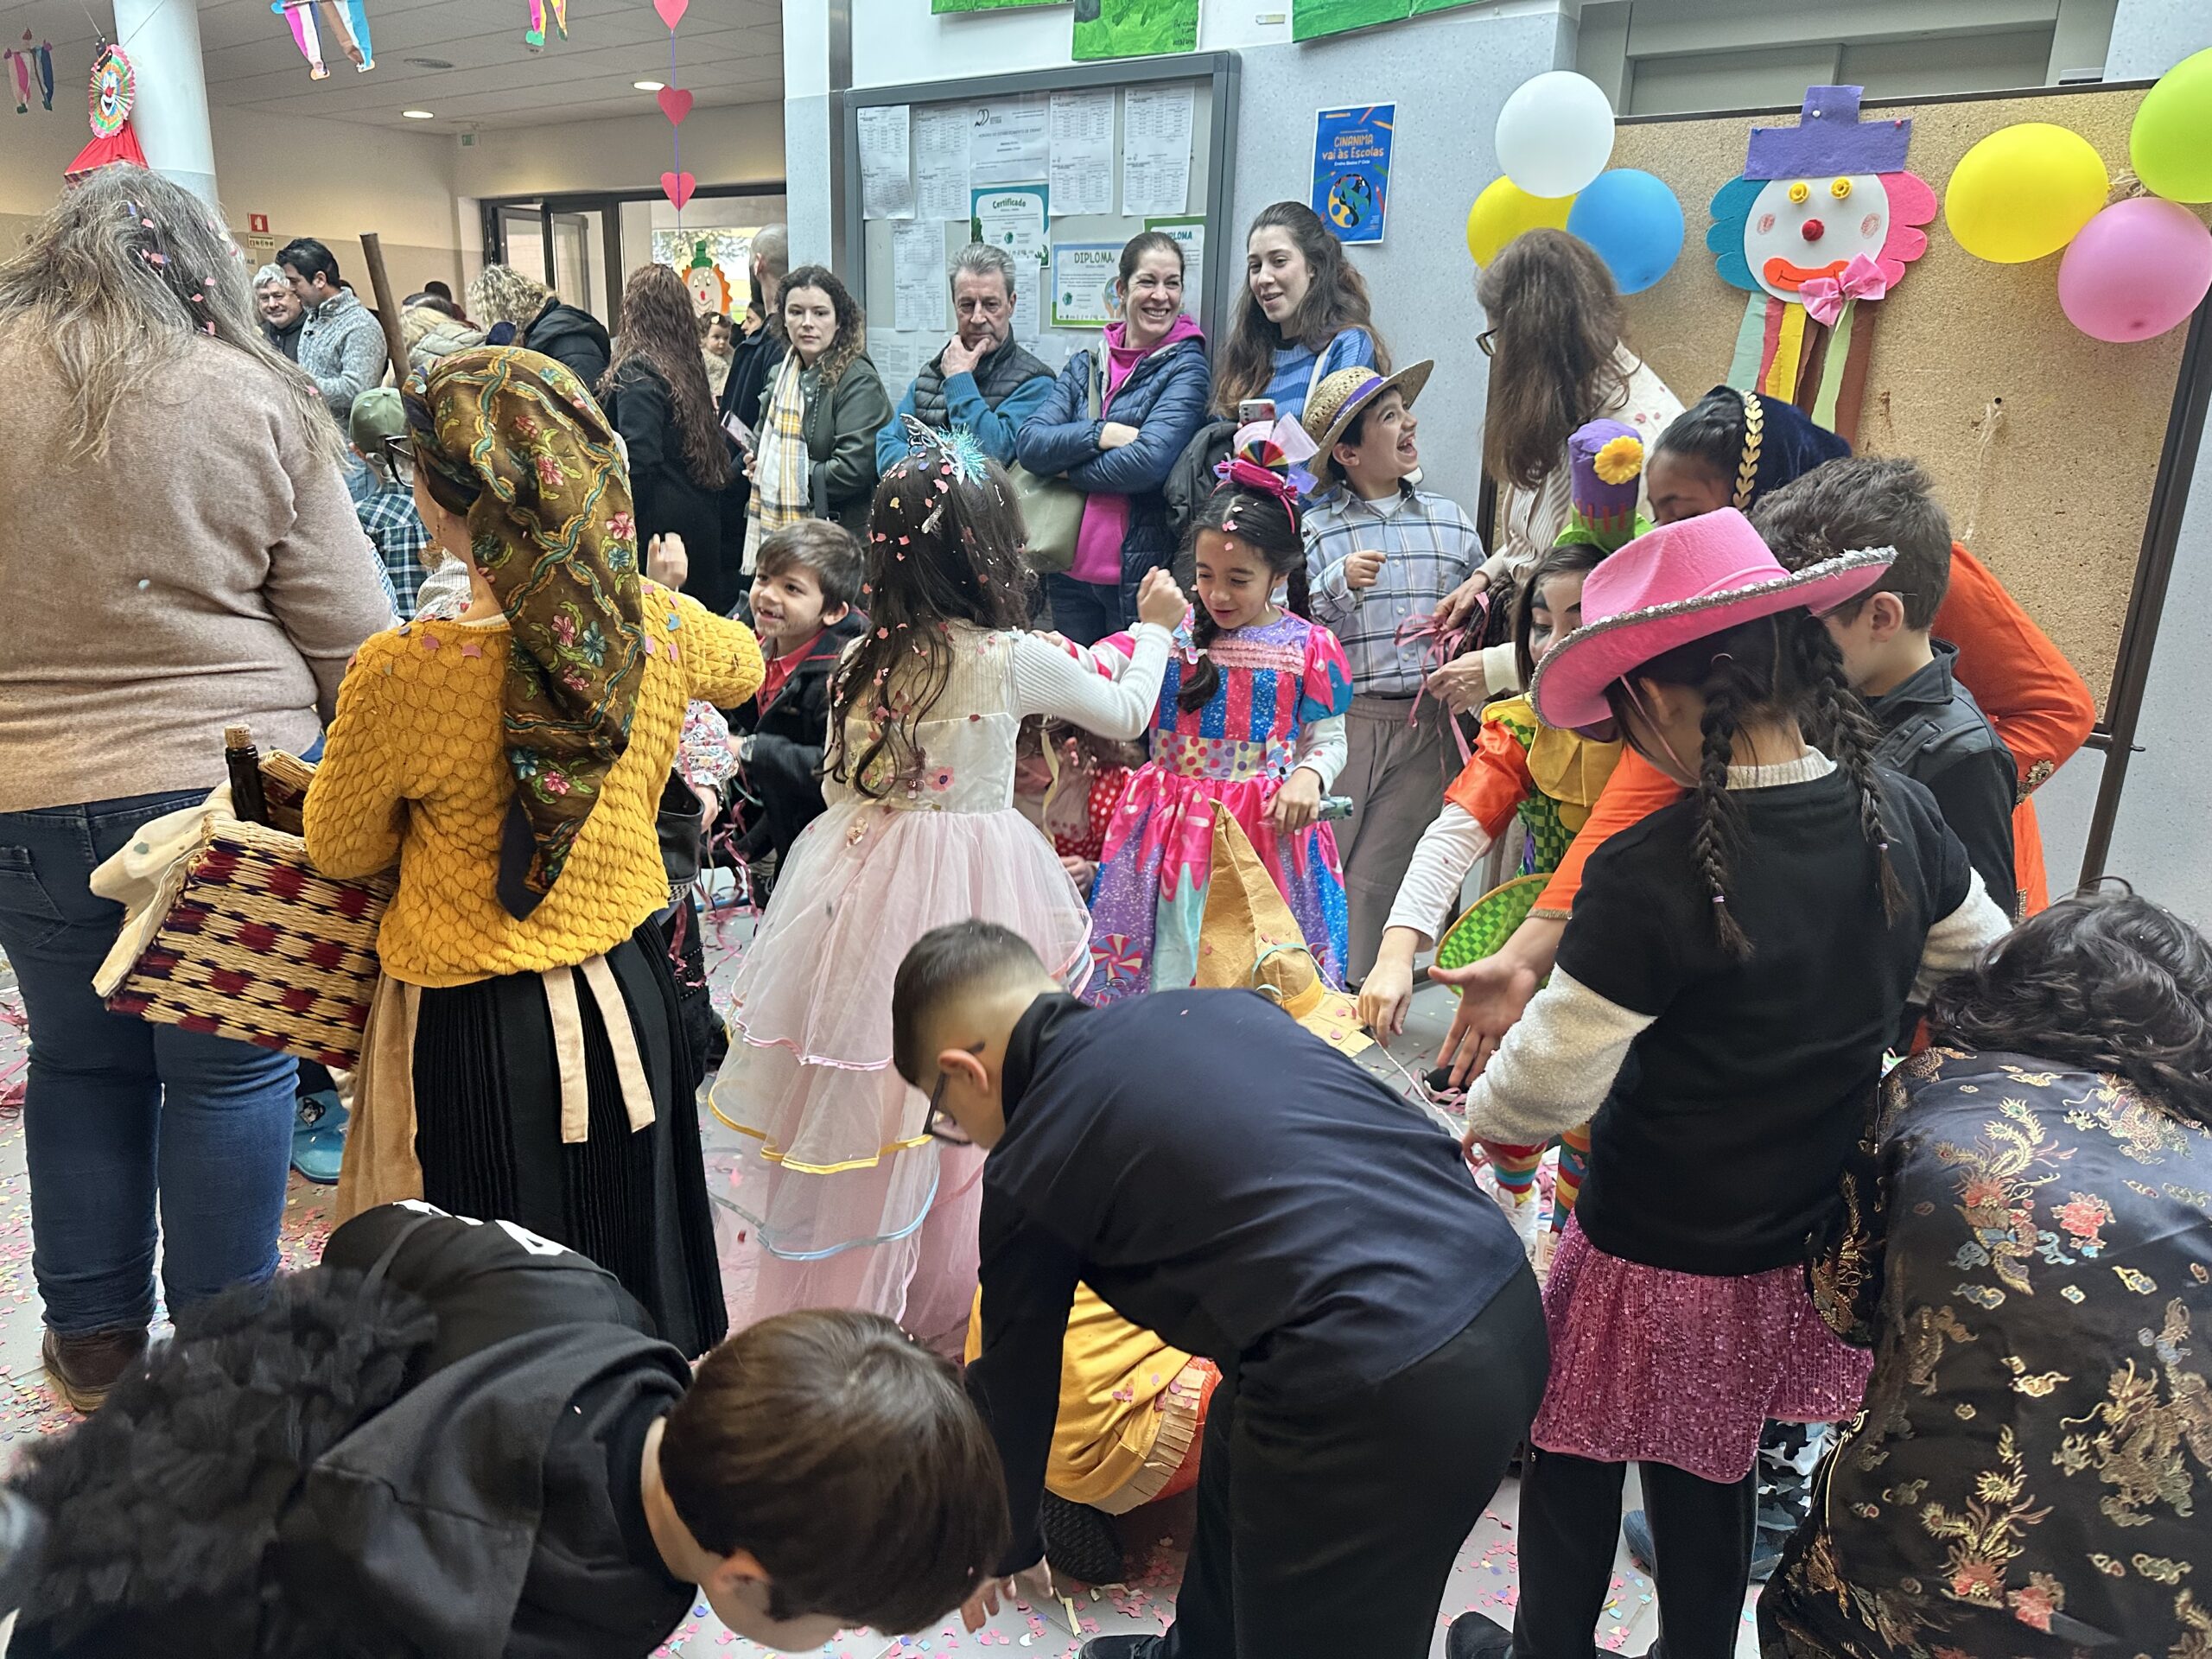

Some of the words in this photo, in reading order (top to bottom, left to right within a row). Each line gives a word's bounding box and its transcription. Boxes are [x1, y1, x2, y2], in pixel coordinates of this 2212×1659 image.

[1334, 134, 1373, 148] CINANIMA
[1322, 148, 1336, 160] vai
[1338, 148, 1349, 159] às
[1351, 146, 1384, 158] Escolas
[992, 198, 1027, 209] Certificado
[1166, 230, 1193, 240] PLOMA
[1074, 251, 1115, 264] DIPLOMA
